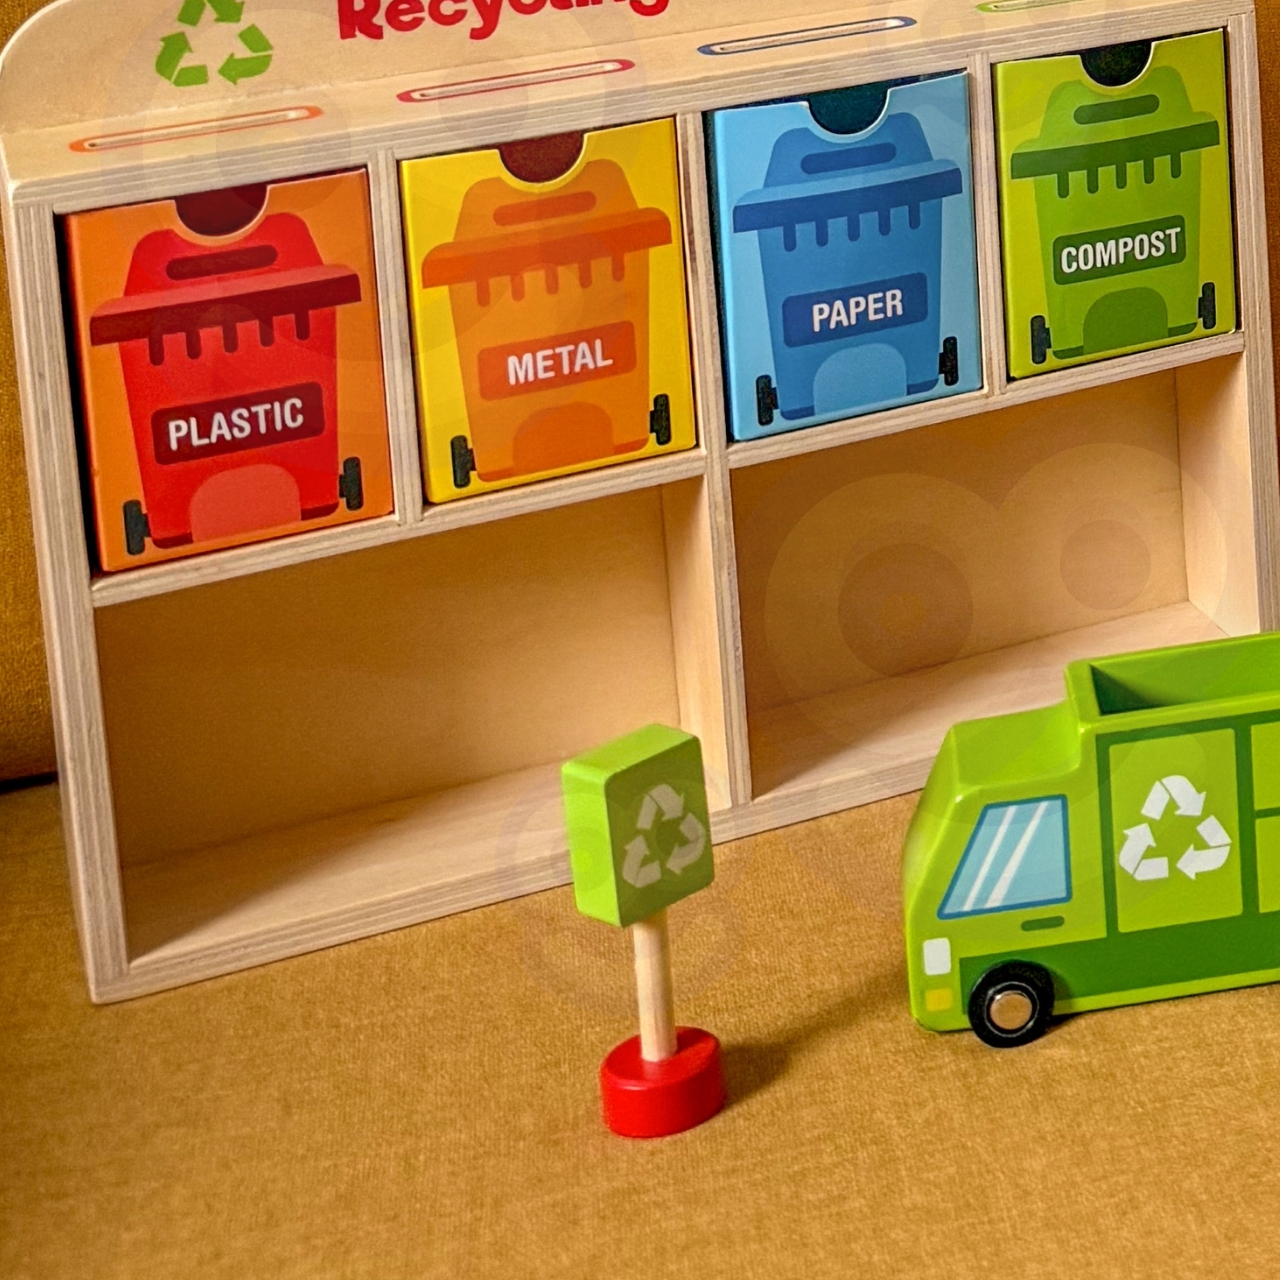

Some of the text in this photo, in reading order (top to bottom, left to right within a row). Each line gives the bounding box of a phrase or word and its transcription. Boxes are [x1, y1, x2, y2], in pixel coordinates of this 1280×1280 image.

[1060, 228, 1181, 275] COMPOST
[811, 288, 904, 333] PAPER
[506, 337, 614, 385] METAL
[167, 398, 305, 451] PLASTIC
